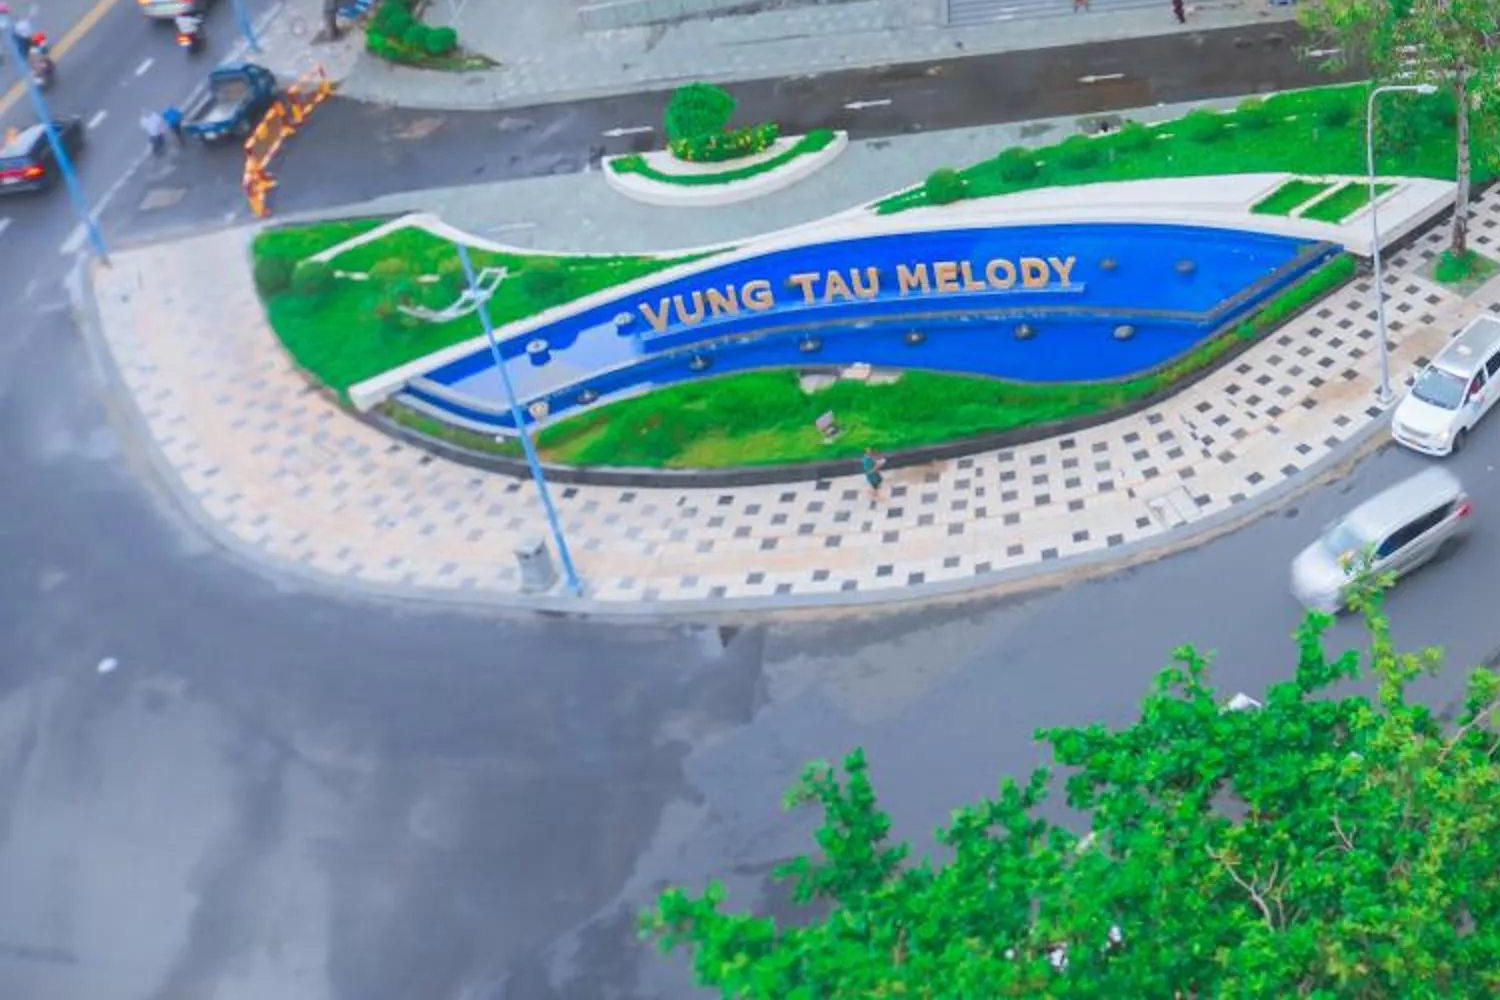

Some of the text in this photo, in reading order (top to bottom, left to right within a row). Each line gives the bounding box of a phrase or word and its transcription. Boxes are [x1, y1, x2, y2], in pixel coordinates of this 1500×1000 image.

[638, 255, 1077, 333] VUNG TAU MELODY
